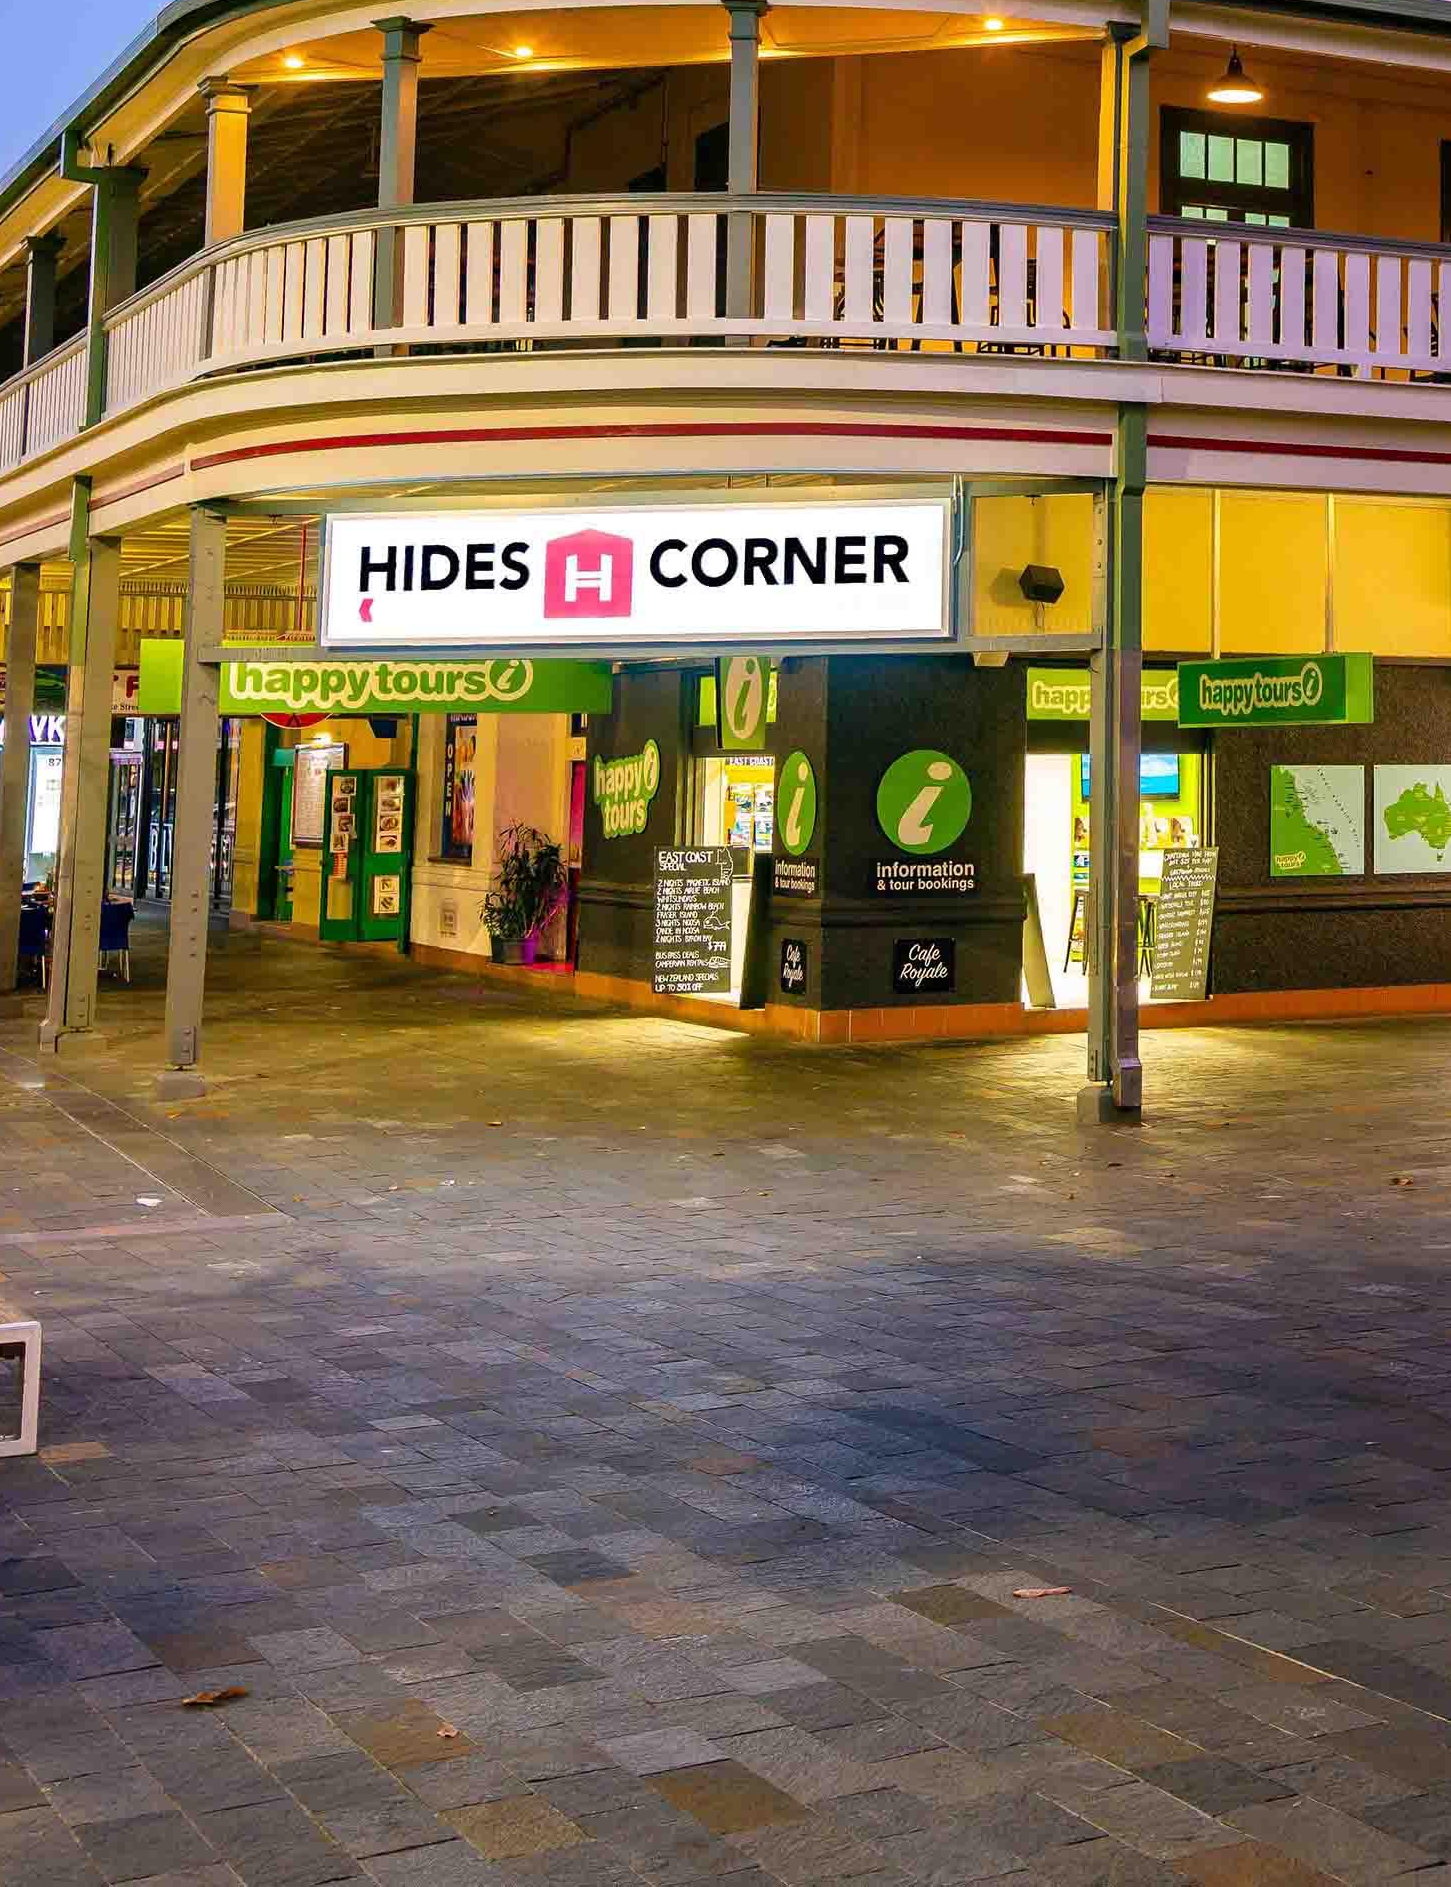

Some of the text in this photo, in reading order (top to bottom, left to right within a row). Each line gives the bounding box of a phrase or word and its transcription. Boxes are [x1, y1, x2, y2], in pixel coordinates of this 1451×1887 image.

[359, 542, 530, 592] HIDES
[650, 535, 909, 589] CORNER
[1035, 682, 1092, 709] happ
[445, 743, 454, 818] OPEN
[596, 759, 645, 802] happy
[603, 799, 646, 833] tours
[658, 851, 714, 863] EAST COAST
[775, 859, 816, 878] information
[877, 860, 975, 878] information
[663, 880, 684, 888] NIGHTS
[780, 878, 790, 889] tour
[790, 878, 815, 894] bookings
[877, 877, 974, 892] & tour bookings
[656, 911, 698, 919] FRASER ISLAND
[661, 919, 681, 927] NIGHTS
[661, 935, 682, 943] NIGHTS
[655, 951, 667, 959] BUS
[682, 951, 700, 959] DEALS
[786, 944, 801, 967] Cafe
[908, 943, 941, 967] Cafe
[655, 974, 669, 983] NEW
[782, 962, 804, 988] Royale
[900, 962, 948, 987] Royale
[655, 984, 665, 992] UP
